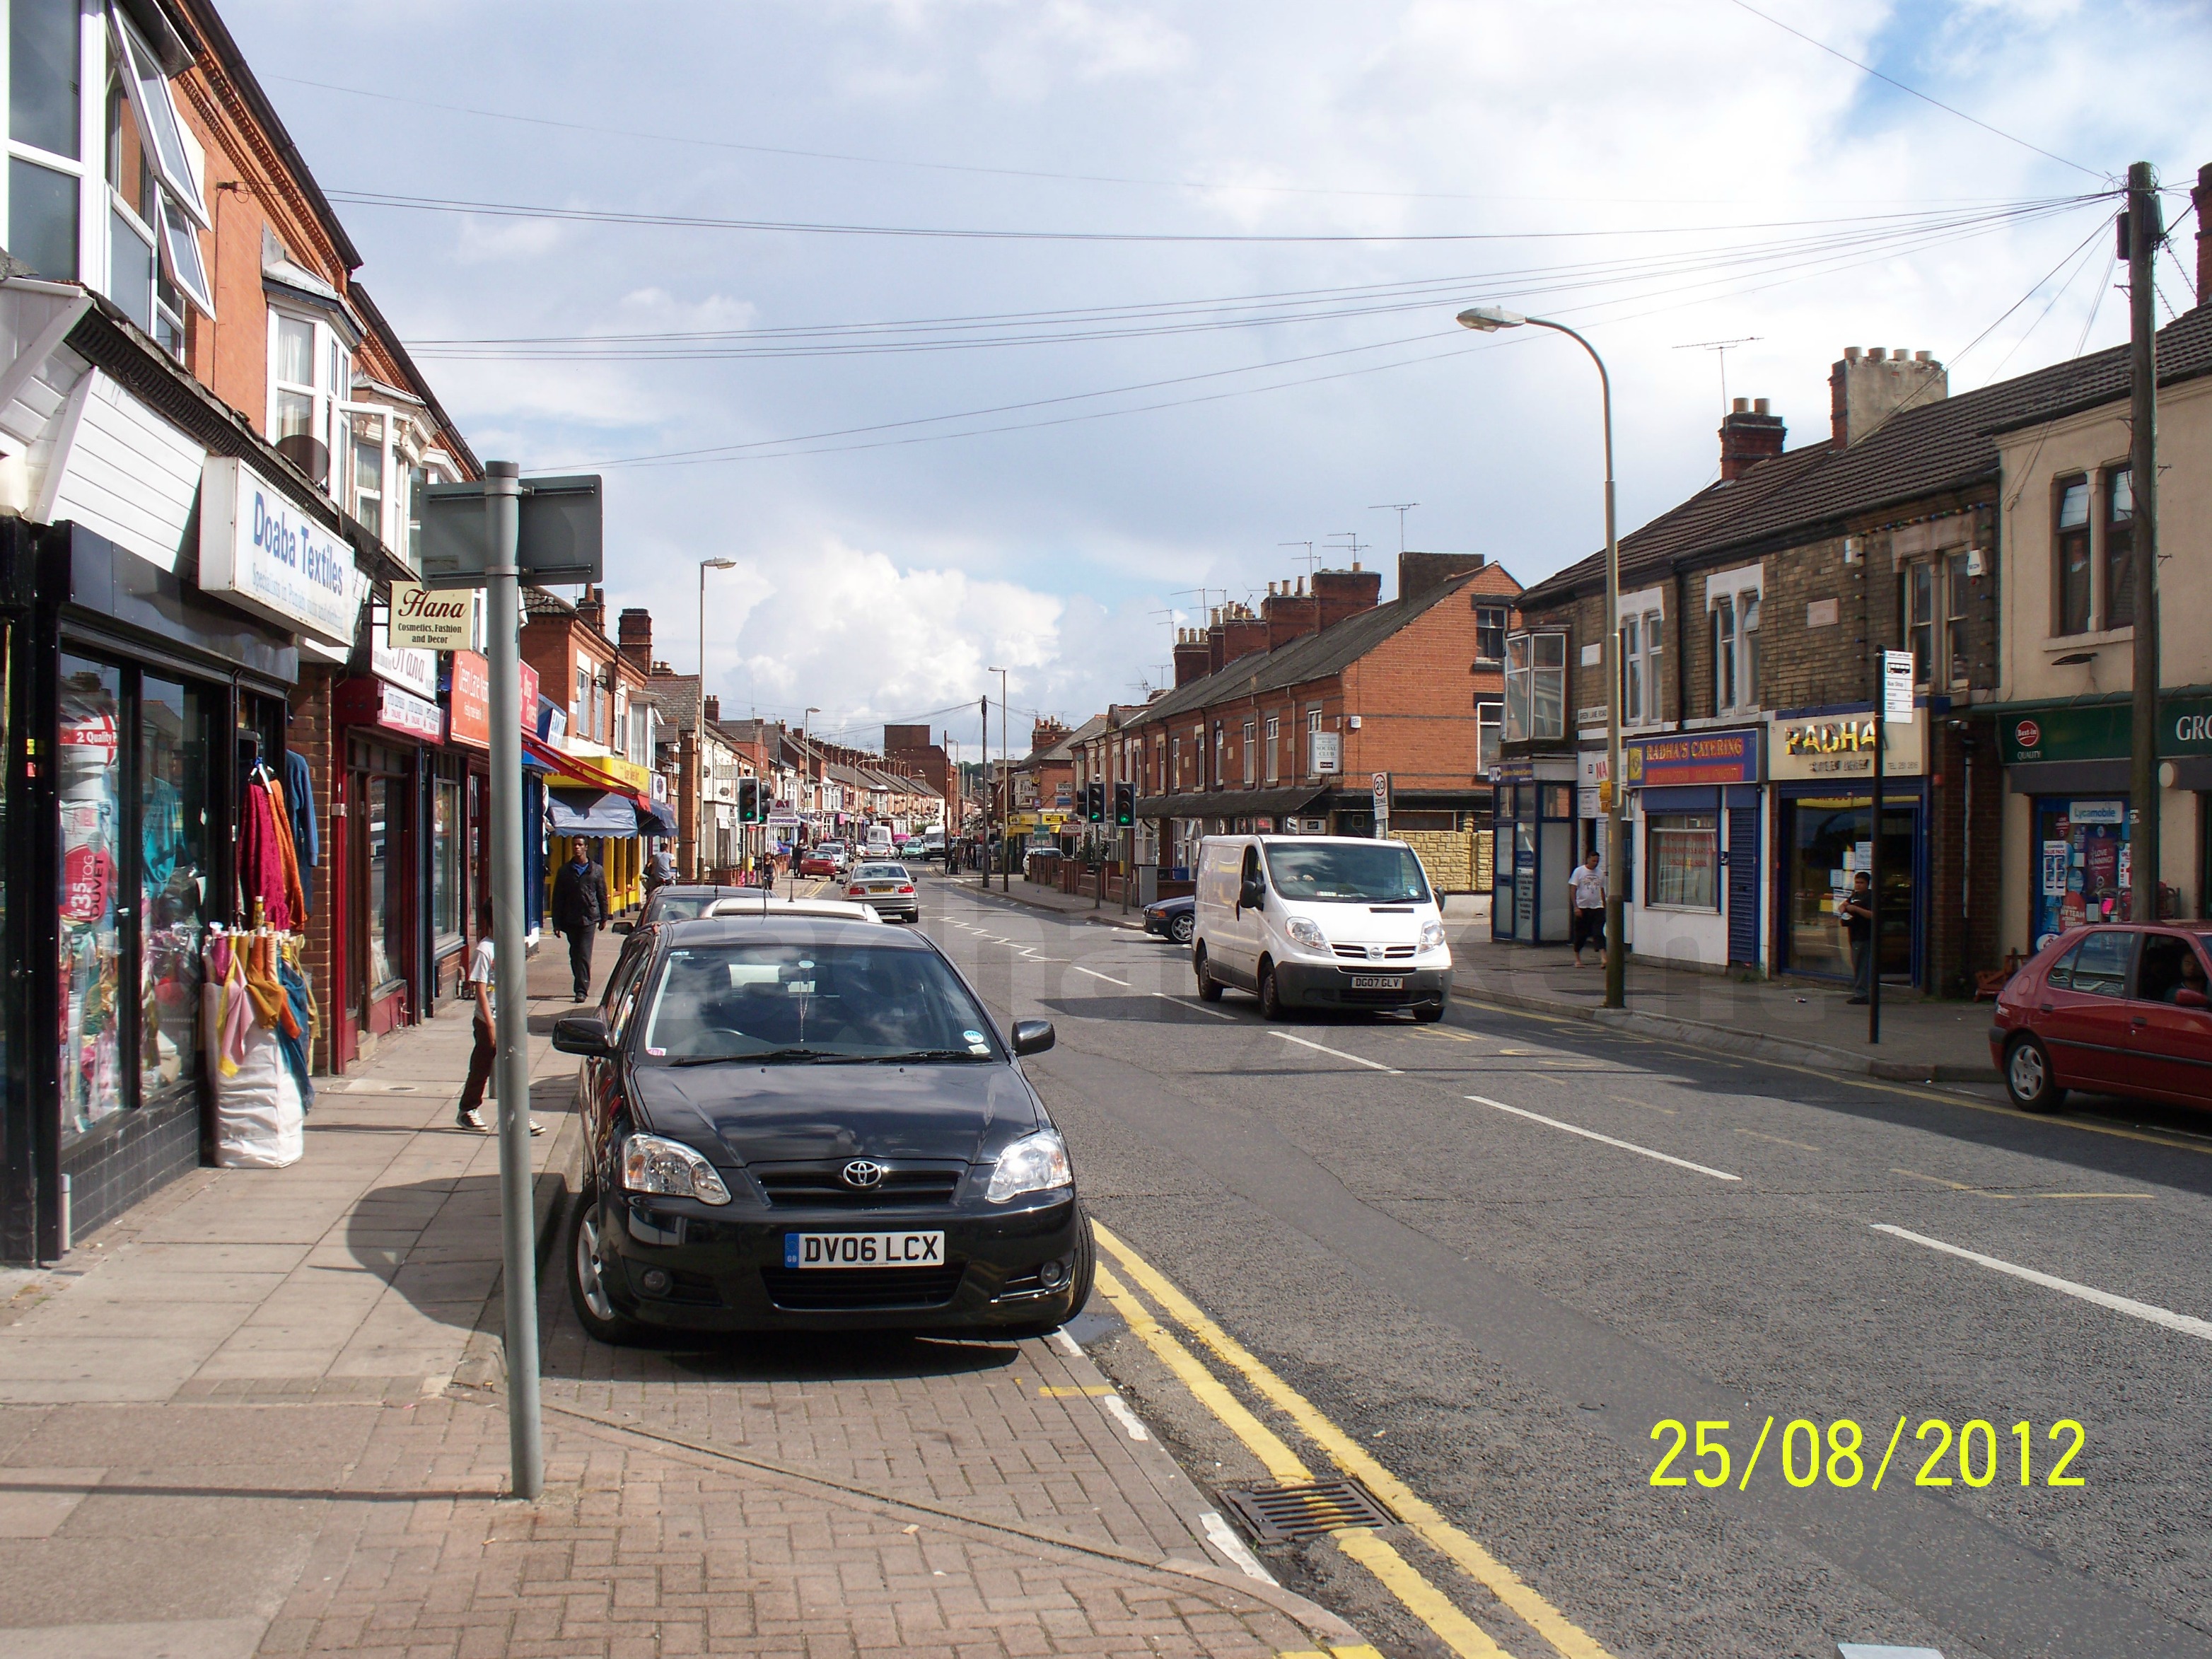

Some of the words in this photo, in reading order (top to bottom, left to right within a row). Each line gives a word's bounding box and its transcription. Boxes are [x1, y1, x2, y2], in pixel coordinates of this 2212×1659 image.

[253, 491, 296, 569] Doaba
[301, 525, 343, 597] Textiles
[397, 588, 467, 619] Hana
[398, 623, 433, 634] Cosmetics,
[435, 624, 462, 634] Fashion
[1578, 711, 1589, 720] GREEN
[1589, 710, 1597, 718] LANE
[76, 732, 85, 743] 2
[86, 730, 112, 746] Quality
[1784, 720, 1889, 755] RADHA
[2018, 728, 2037, 737] Best-in
[1646, 740, 1689, 763] RADHA'S
[1689, 736, 1745, 759] CATERING
[2017, 750, 2041, 761] QUALITY
[1375, 780, 1384, 791] 20
[775, 800, 790, 808] A1
[2074, 807, 2116, 819] Lycamobile
[81, 855, 95, 883] TOG
[91, 856, 104, 918] DUVET
[2071, 910, 2085, 919] TEAM
[1356, 978, 1379, 987] DG07
[1381, 979, 1399, 987] GLV
[804, 1236, 877, 1262] DV06
[885, 1235, 938, 1261] LCX
